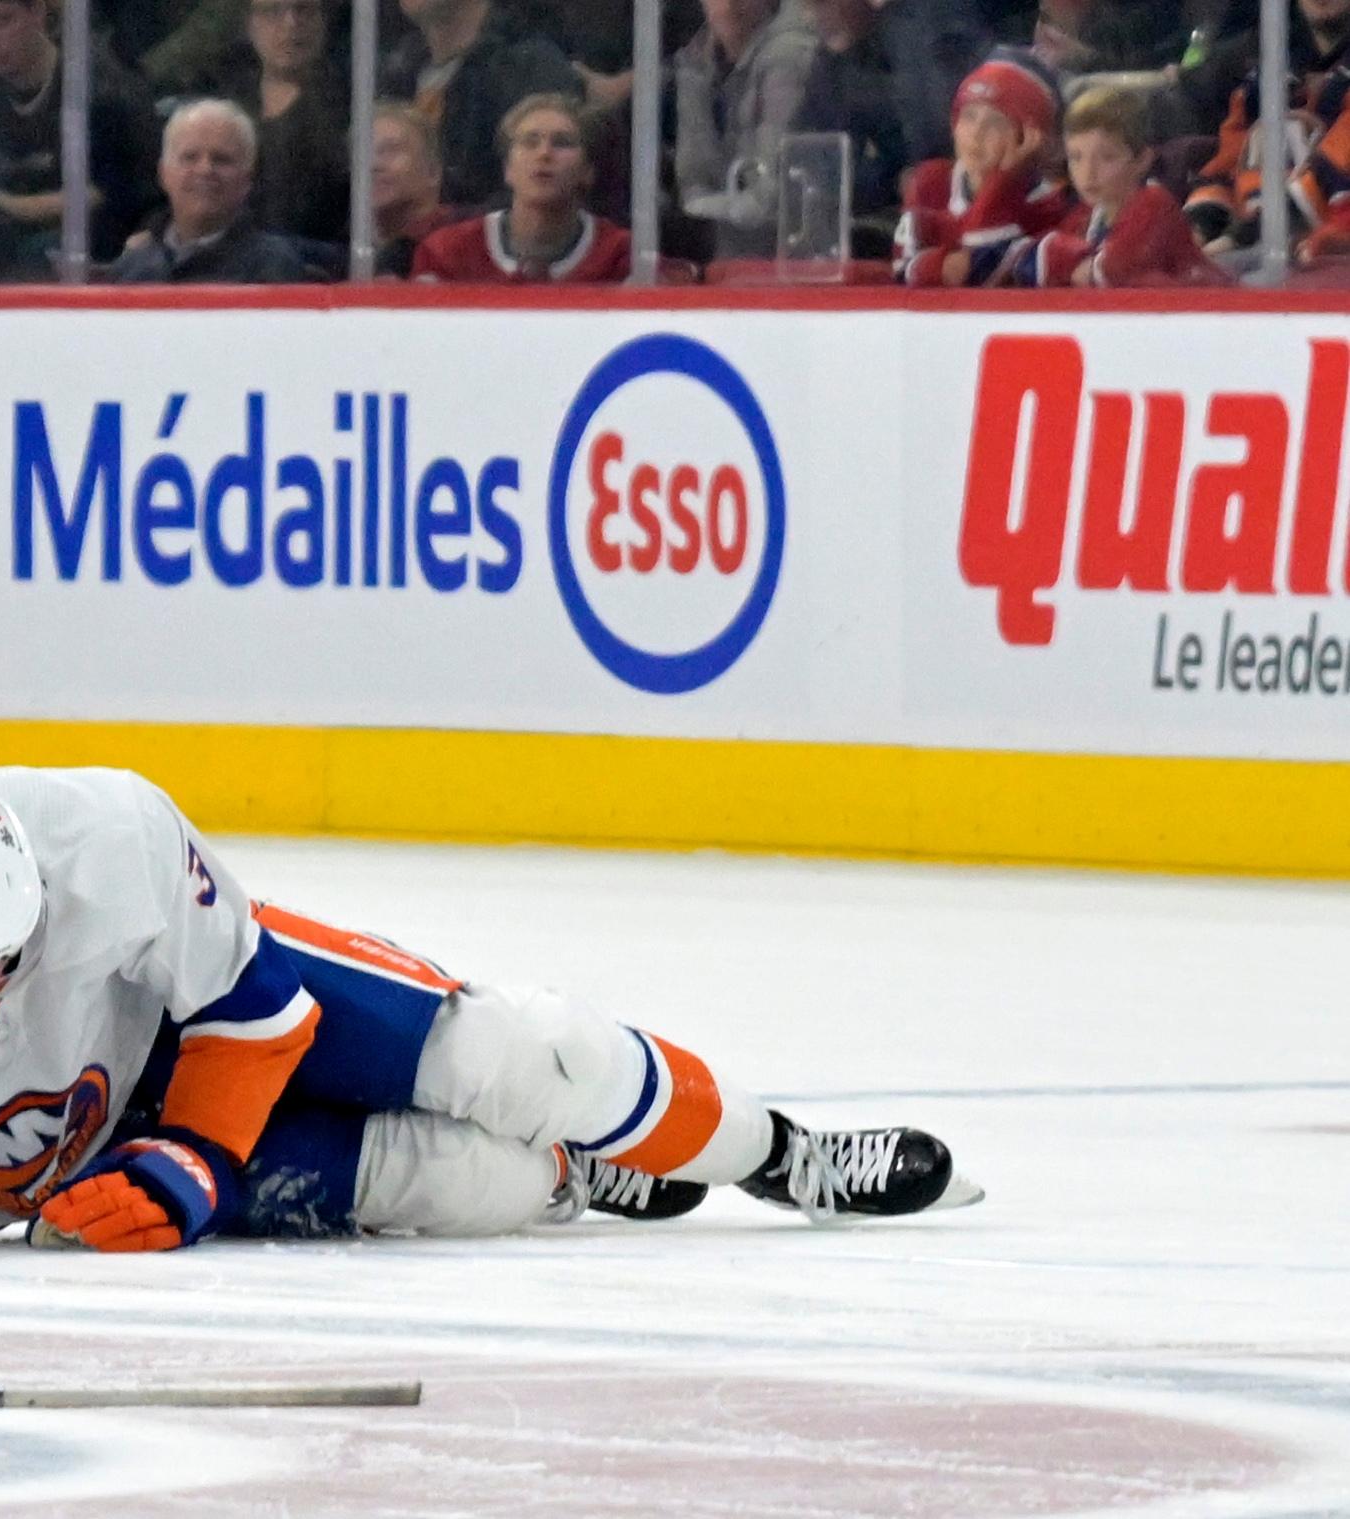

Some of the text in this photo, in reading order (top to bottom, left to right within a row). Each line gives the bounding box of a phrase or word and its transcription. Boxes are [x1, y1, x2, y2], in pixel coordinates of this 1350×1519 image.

[11, 390, 526, 596] Médailles
[585, 430, 750, 576] Esso
[957, 331, 1350, 648] Qual
[1152, 610, 1350, 696] Le leade
